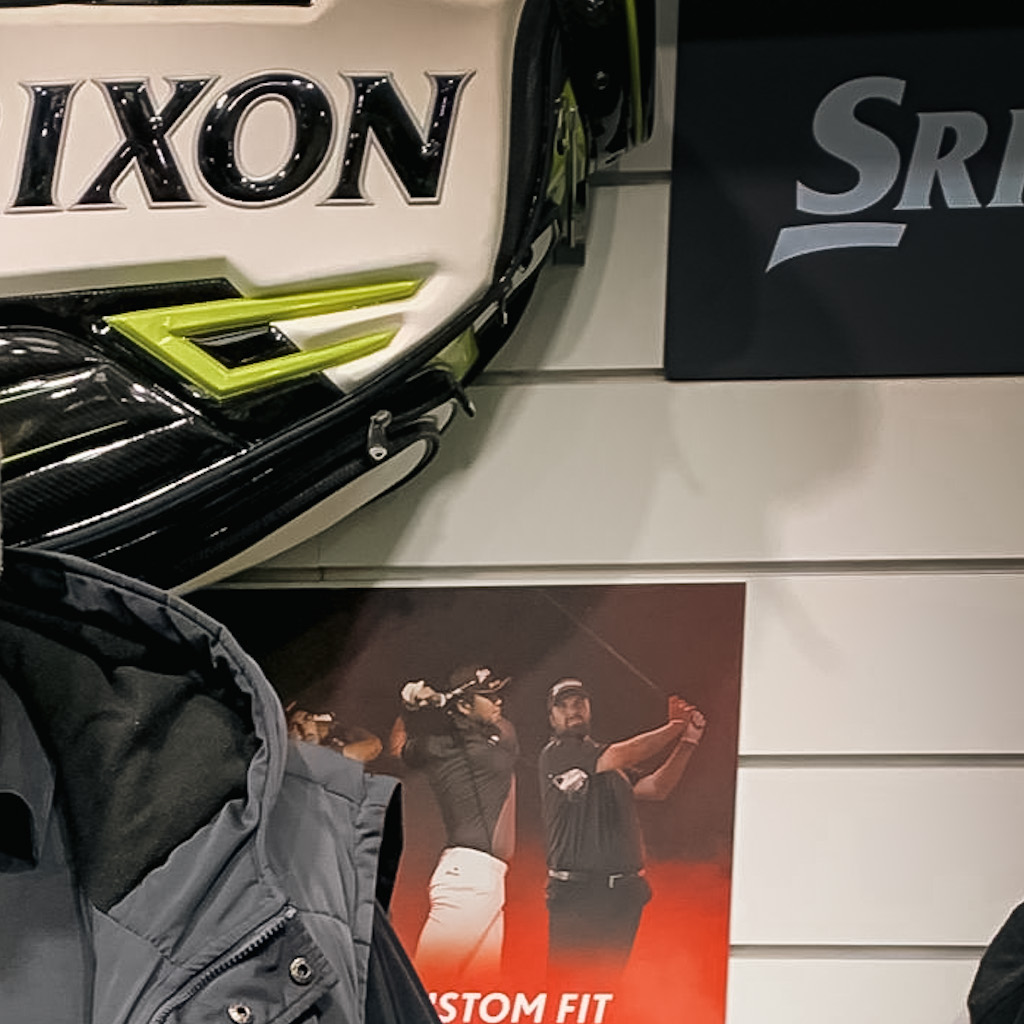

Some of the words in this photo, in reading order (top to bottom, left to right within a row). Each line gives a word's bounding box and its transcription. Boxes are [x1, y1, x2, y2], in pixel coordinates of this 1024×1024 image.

[796, 76, 1024, 216] SRI
[428, 992, 548, 1024] STOM
[556, 993, 614, 1024] FIT
